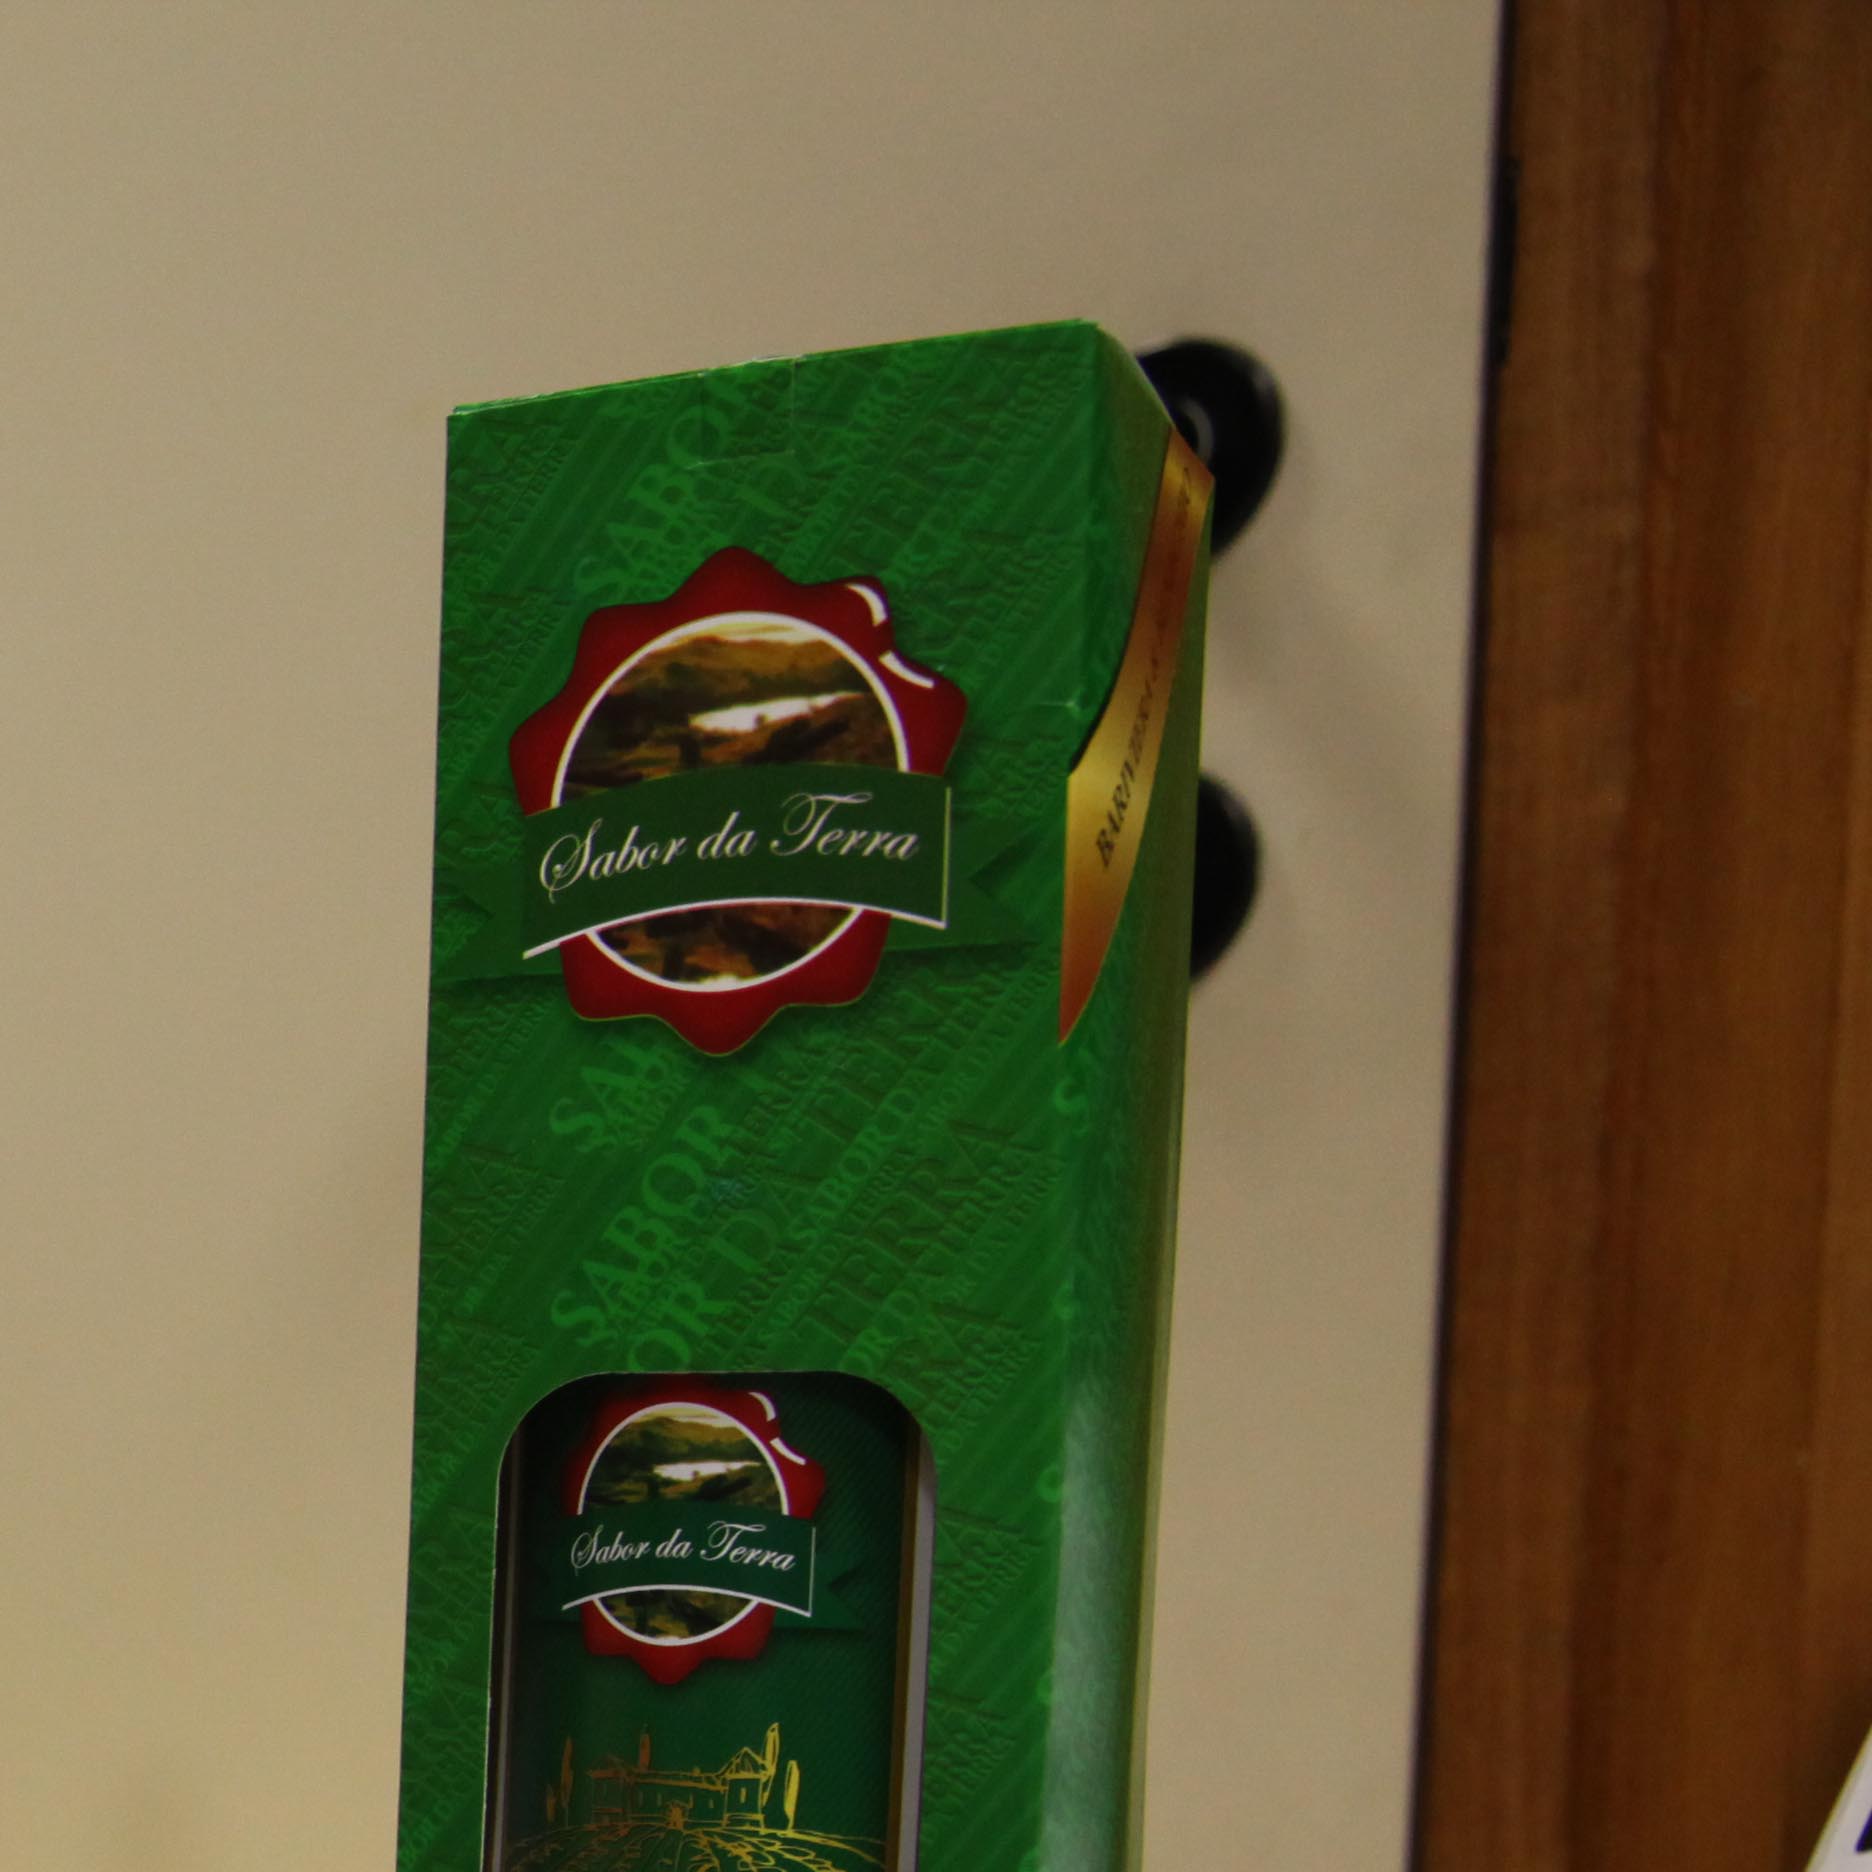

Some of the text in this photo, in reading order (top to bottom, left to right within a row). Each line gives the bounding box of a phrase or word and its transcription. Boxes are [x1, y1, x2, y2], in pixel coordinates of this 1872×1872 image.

[539, 790, 921, 904] Sabor da Terra
[550, 1105, 733, 1348] SABOR
[570, 1520, 796, 1577] Sabor da Terra
